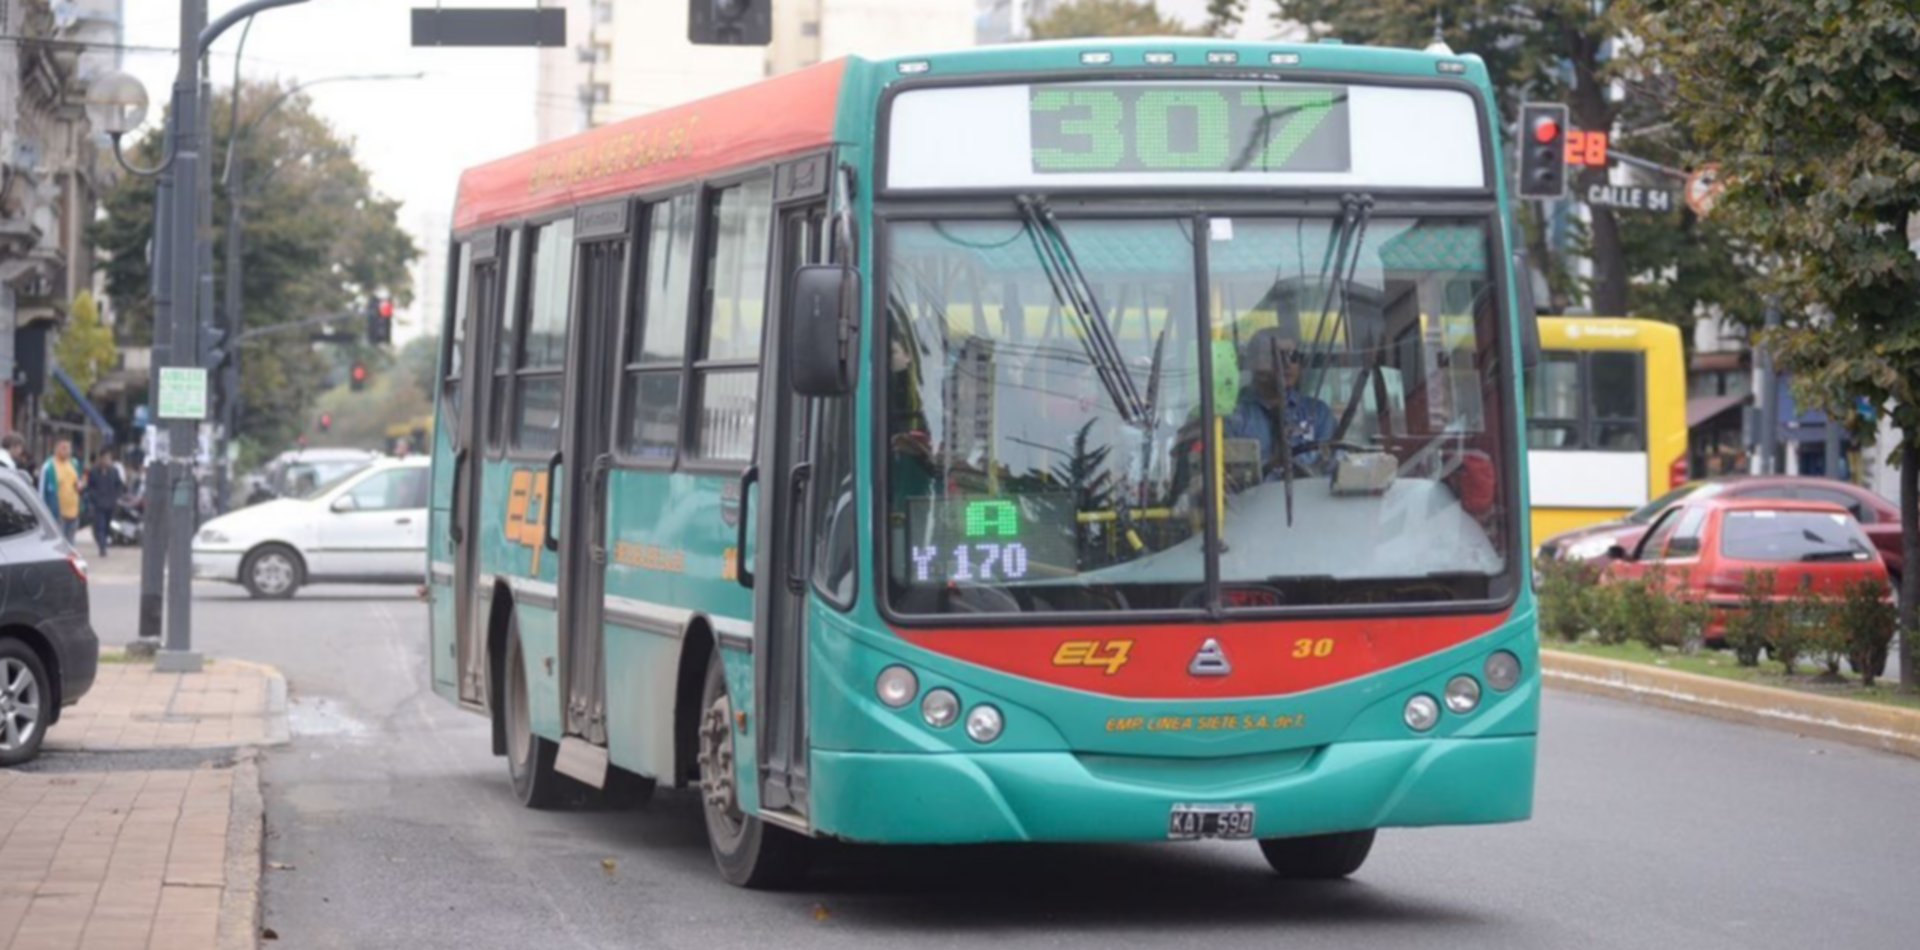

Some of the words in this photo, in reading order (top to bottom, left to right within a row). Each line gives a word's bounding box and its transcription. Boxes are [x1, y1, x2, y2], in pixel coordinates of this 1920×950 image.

[1030, 91, 1333, 168] 307
[1567, 131, 1606, 165] 28
[1588, 184, 1642, 209] CALLE
[965, 501, 1017, 536] A
[912, 546, 937, 581] Y
[953, 543, 1028, 580] 170
[1053, 640, 1134, 675] EL7
[1291, 637, 1334, 658] 30
[1146, 716, 1193, 732] LINEA
[1197, 714, 1238, 731] SIETE
[1216, 811, 1251, 834] 594
